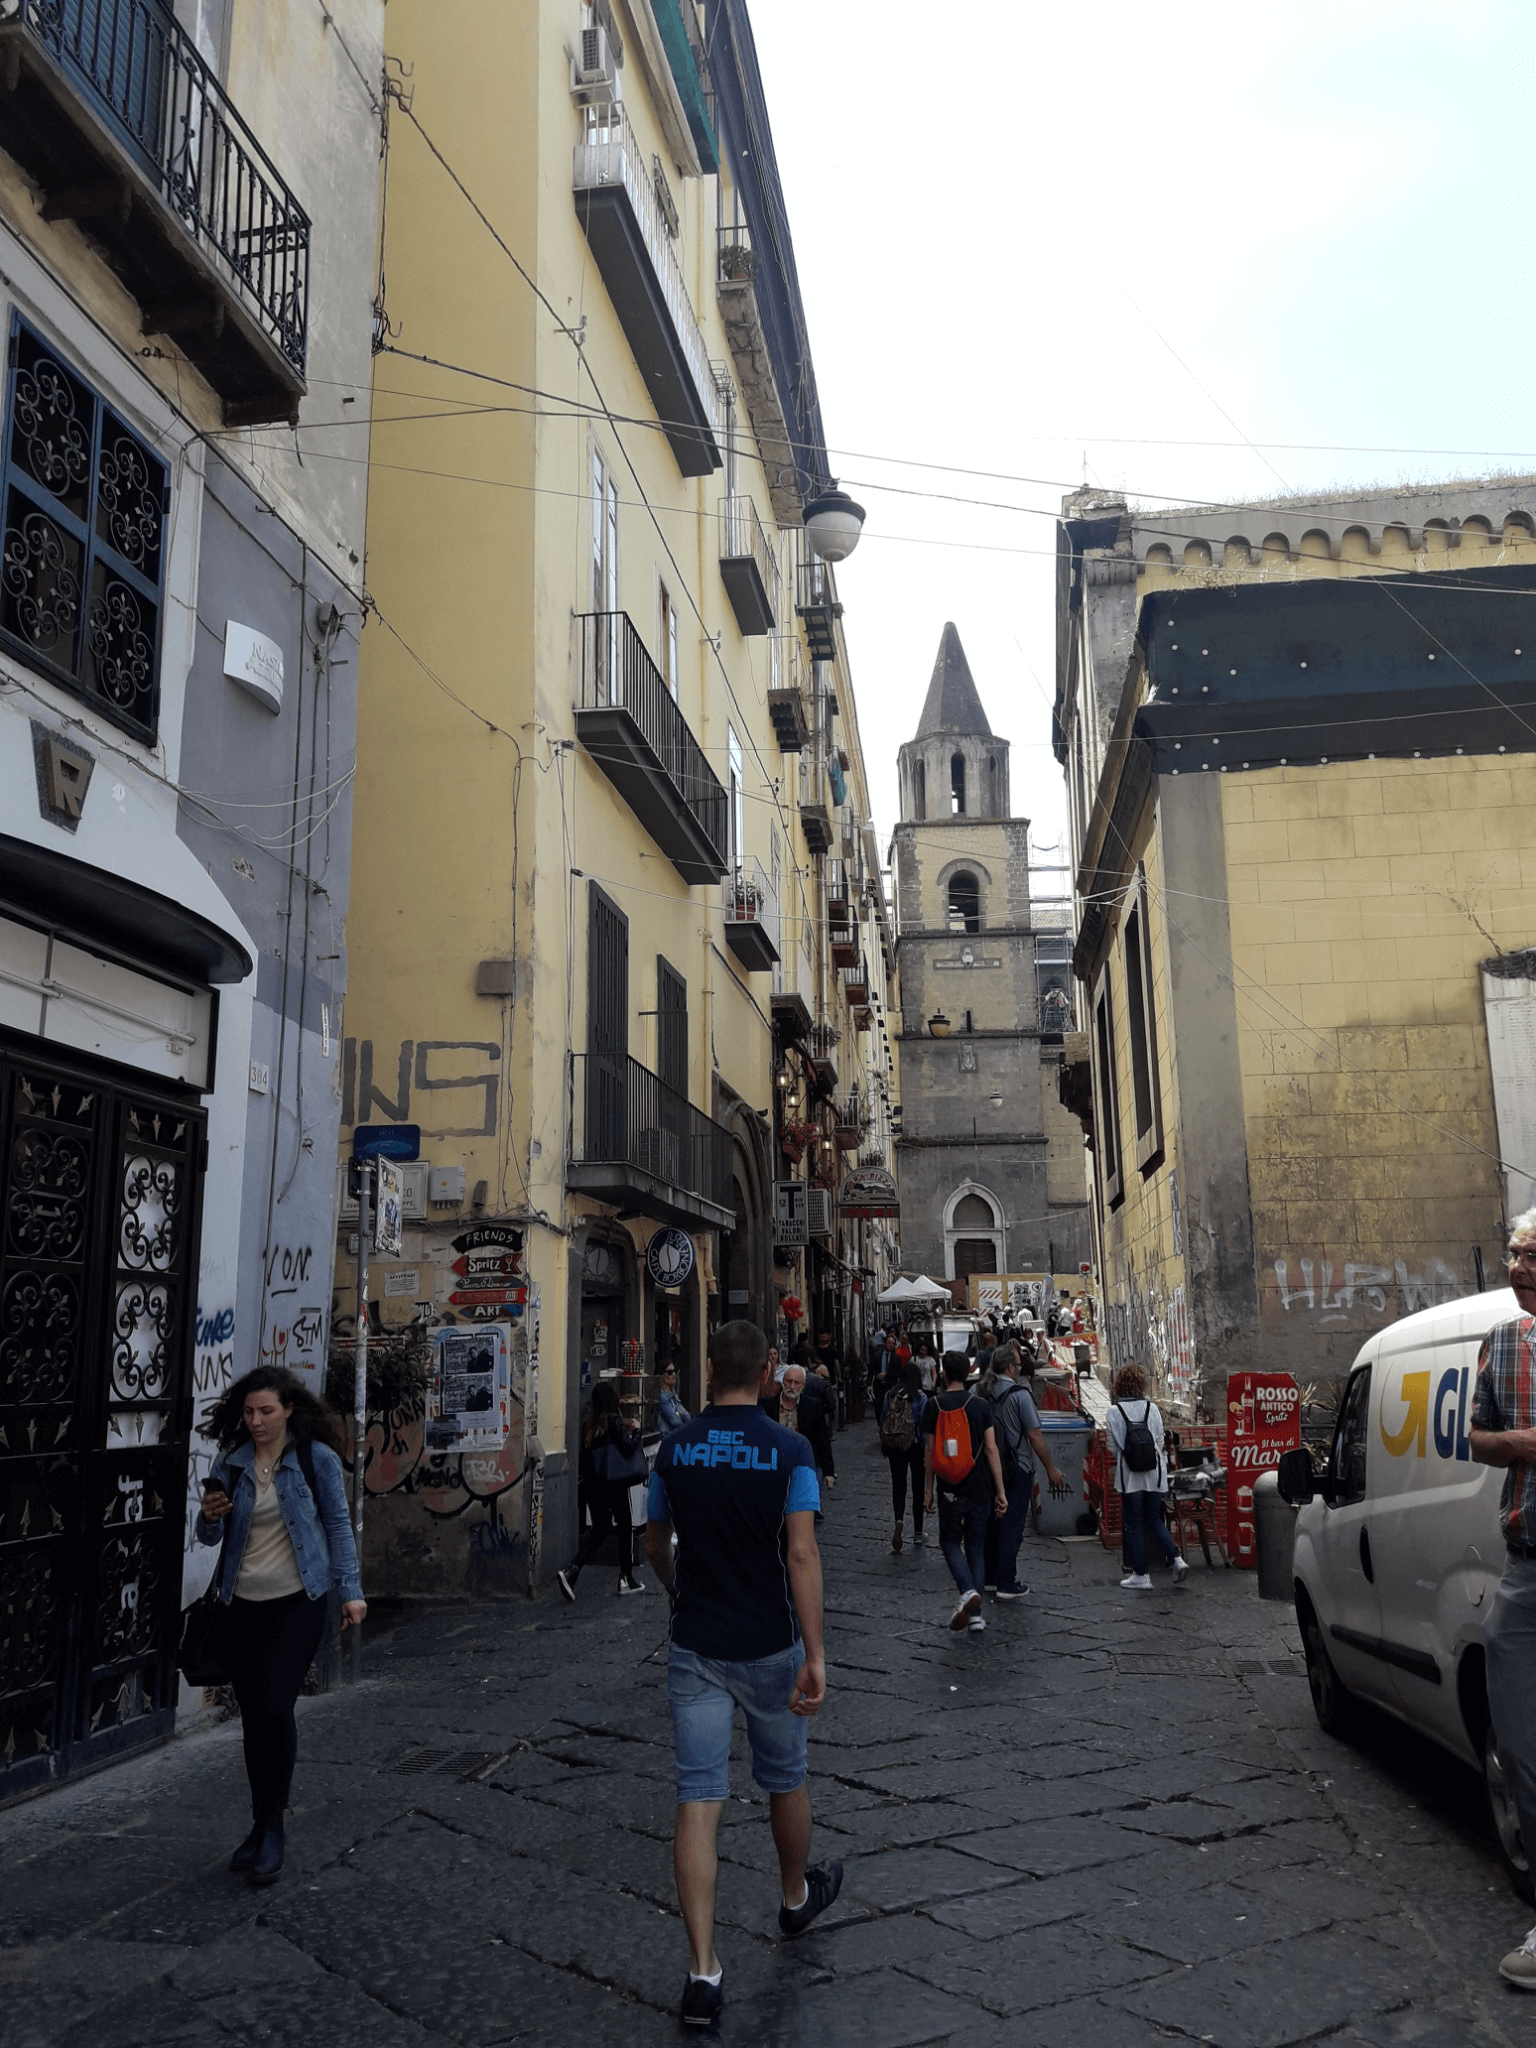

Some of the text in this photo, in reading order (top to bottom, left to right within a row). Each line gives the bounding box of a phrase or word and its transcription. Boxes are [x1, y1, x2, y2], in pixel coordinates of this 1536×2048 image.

[251, 1066, 267, 1086] 384
[869, 1172, 891, 1190] PIZZA
[780, 1186, 802, 1218] T
[779, 1219, 805, 1227] TABACCHI
[466, 1229, 513, 1245] FRIENDS
[468, 1258, 501, 1272] Spritz
[662, 1246, 691, 1284] BORBONE
[474, 1305, 502, 1317] ART
[1256, 1387, 1298, 1401] ROSSO
[1260, 1402, 1294, 1412] ANTICO
[1434, 1367, 1471, 1462] GL
[673, 1443, 778, 1470] NAPOLI
[1231, 1444, 1282, 1467] Mar
